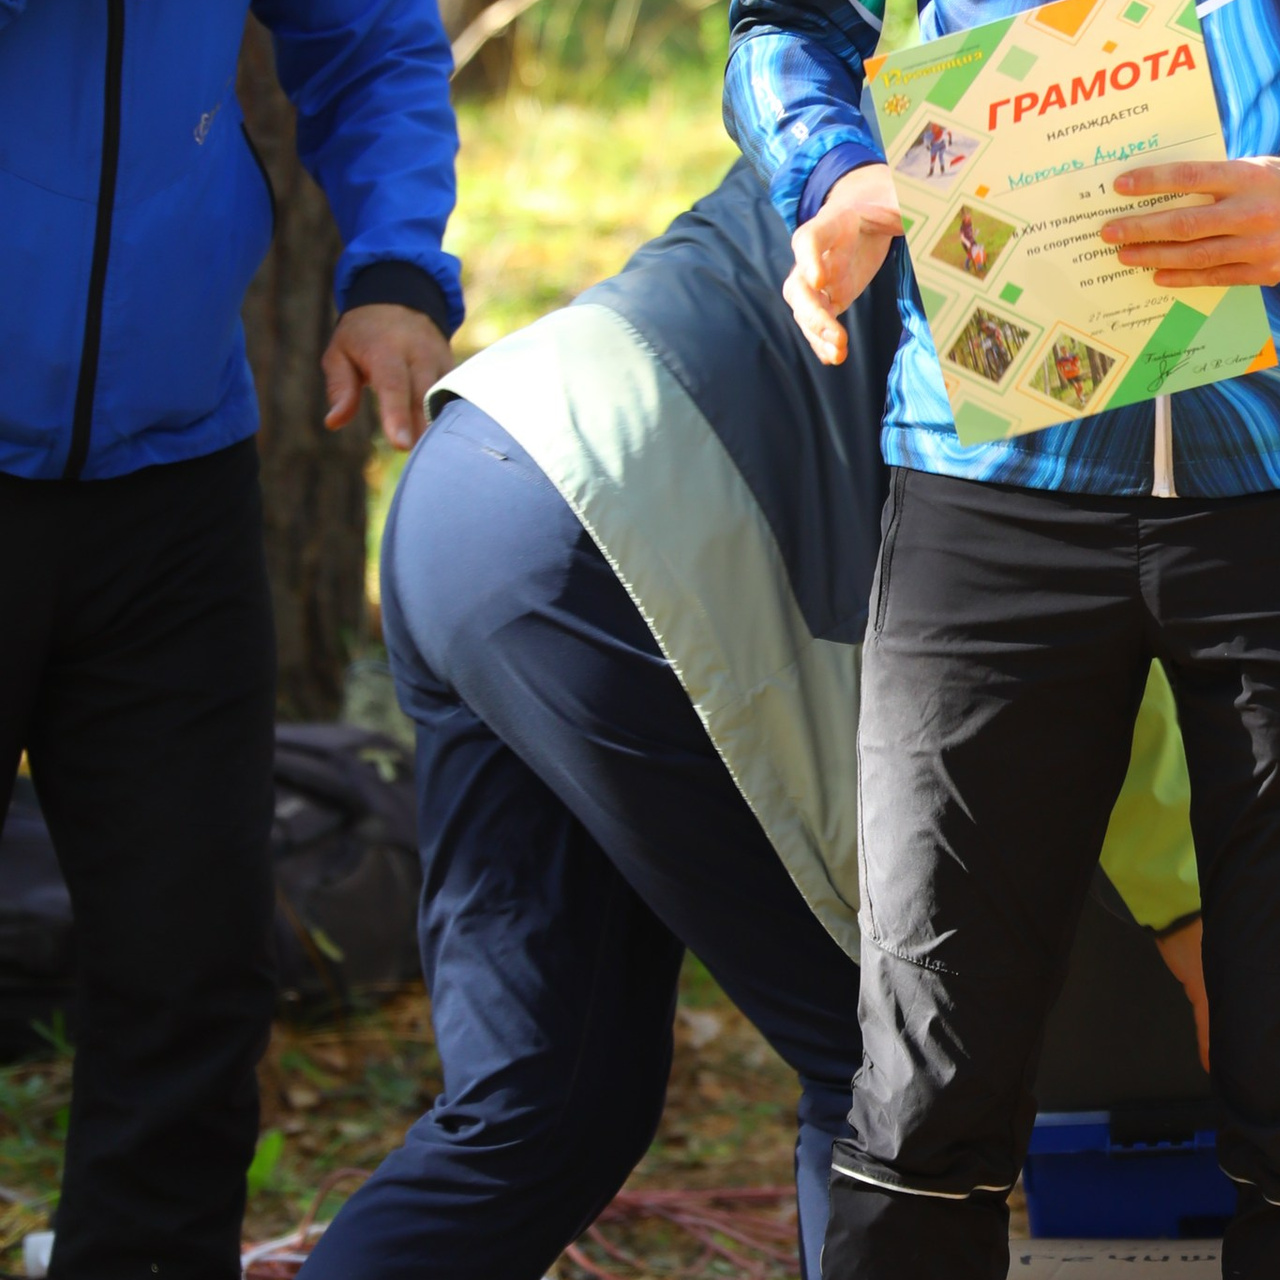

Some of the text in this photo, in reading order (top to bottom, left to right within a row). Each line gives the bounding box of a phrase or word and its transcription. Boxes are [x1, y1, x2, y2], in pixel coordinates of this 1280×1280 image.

[988, 43, 1197, 132] ГРАМОТА
[1047, 103, 1150, 142] НАГРАЖДАЕТСЯ
[1079, 183, 1107, 200] за 1
[1021, 222, 1048, 236] XXVI
[1050, 203, 1135, 228] традиционных
[1027, 246, 1041, 256] по
[1080, 279, 1094, 288] по
[1096, 267, 1139, 284] группе:
